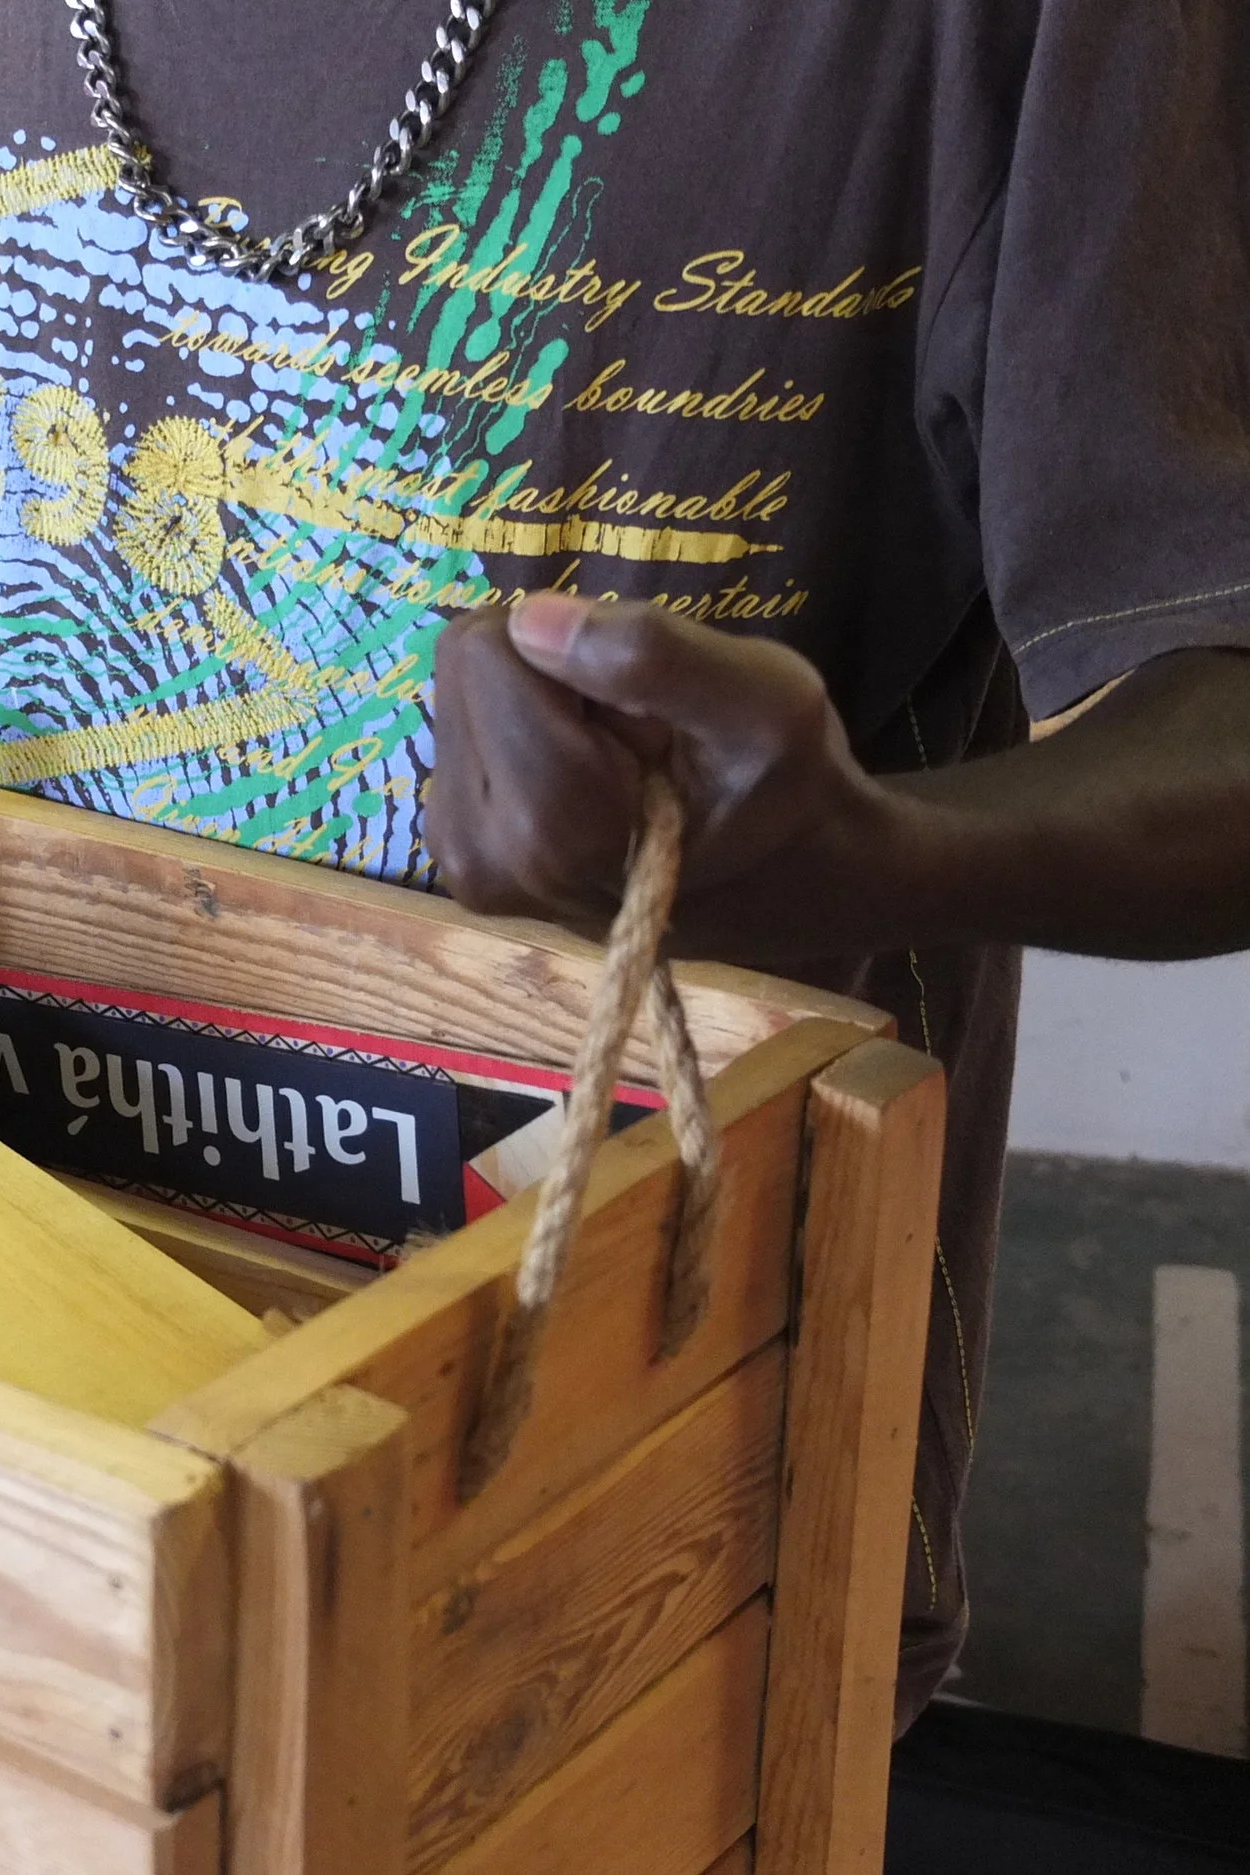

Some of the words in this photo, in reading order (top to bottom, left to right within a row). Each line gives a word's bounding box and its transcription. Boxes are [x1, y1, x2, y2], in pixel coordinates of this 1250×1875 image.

[398, 223, 641, 333] Industry
[159, 310, 340, 377] towards
[561, 358, 826, 422] boundries
[470, 458, 792, 526] fashionable
[53, 1041, 422, 1206] Lathithá
